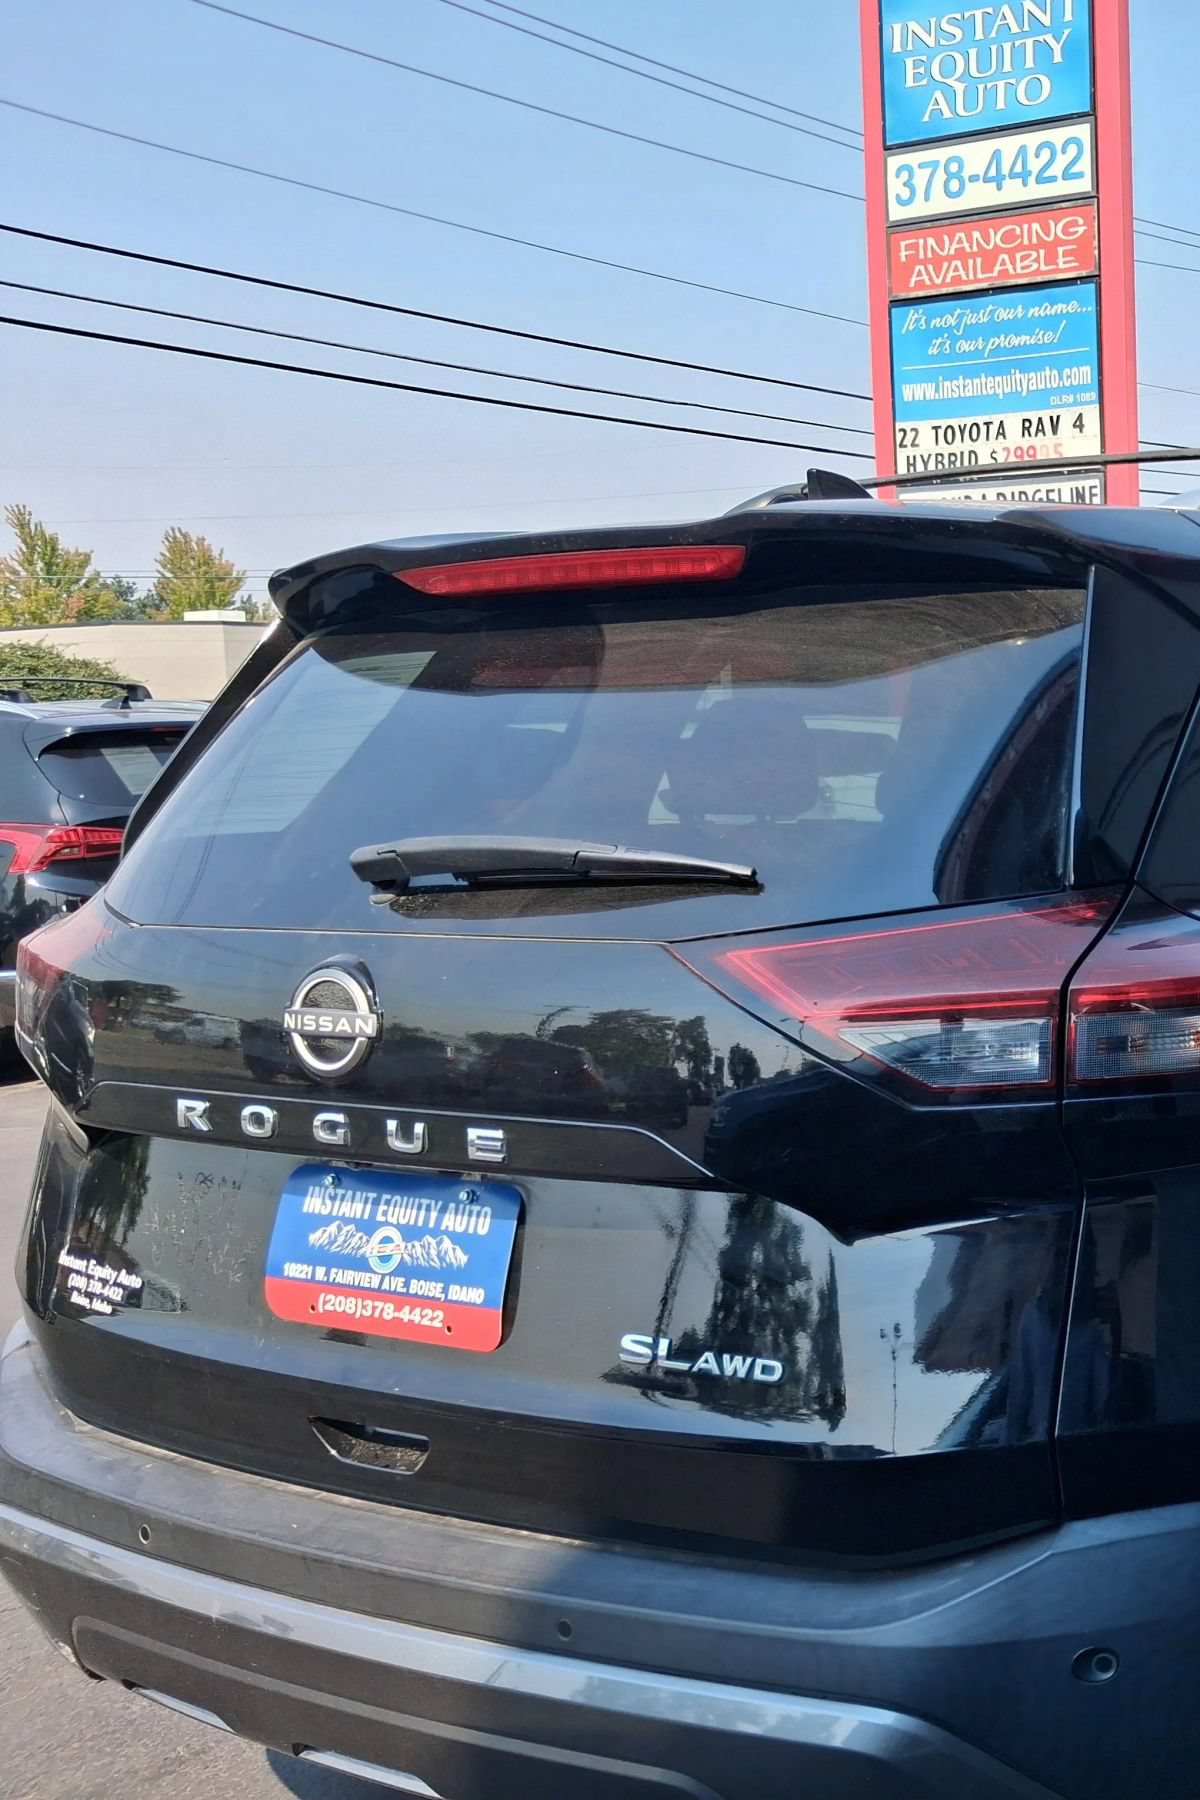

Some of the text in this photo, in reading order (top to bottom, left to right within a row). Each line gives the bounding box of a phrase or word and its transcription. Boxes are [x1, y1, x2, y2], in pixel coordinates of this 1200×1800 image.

[891, 0, 1073, 53] INSTANT
[904, 28, 1072, 88] EQUITY
[921, 73, 1051, 122] AUTO
[895, 136, 1085, 207] 378-4422
[899, 216, 1088, 262] FINANCING
[908, 245, 1080, 288] AVAILABLE
[902, 300, 1093, 335] It's not just our name...
[927, 320, 1067, 358] it's our promise!
[902, 365, 1092, 402] www.instantequityauto.com
[898, 412, 1085, 449] 22 TOYOTA RAV 4
[907, 449, 979, 474] HYBRID
[284, 1012, 374, 1035] NISSAN
[177, 1098, 508, 1164] ROGUE
[302, 1186, 492, 1235] INSTANT EQUITY AUTO
[58, 1250, 143, 1289] Instant Equity Auto
[283, 1262, 312, 1280] 10221
[329, 1267, 381, 1289] FAIRVIEW
[381, 1275, 406, 1293] AVE.
[409, 1278, 446, 1301] BOISE,
[447, 1284, 485, 1304] IDAHO
[318, 1292, 445, 1328] (208)378-4422
